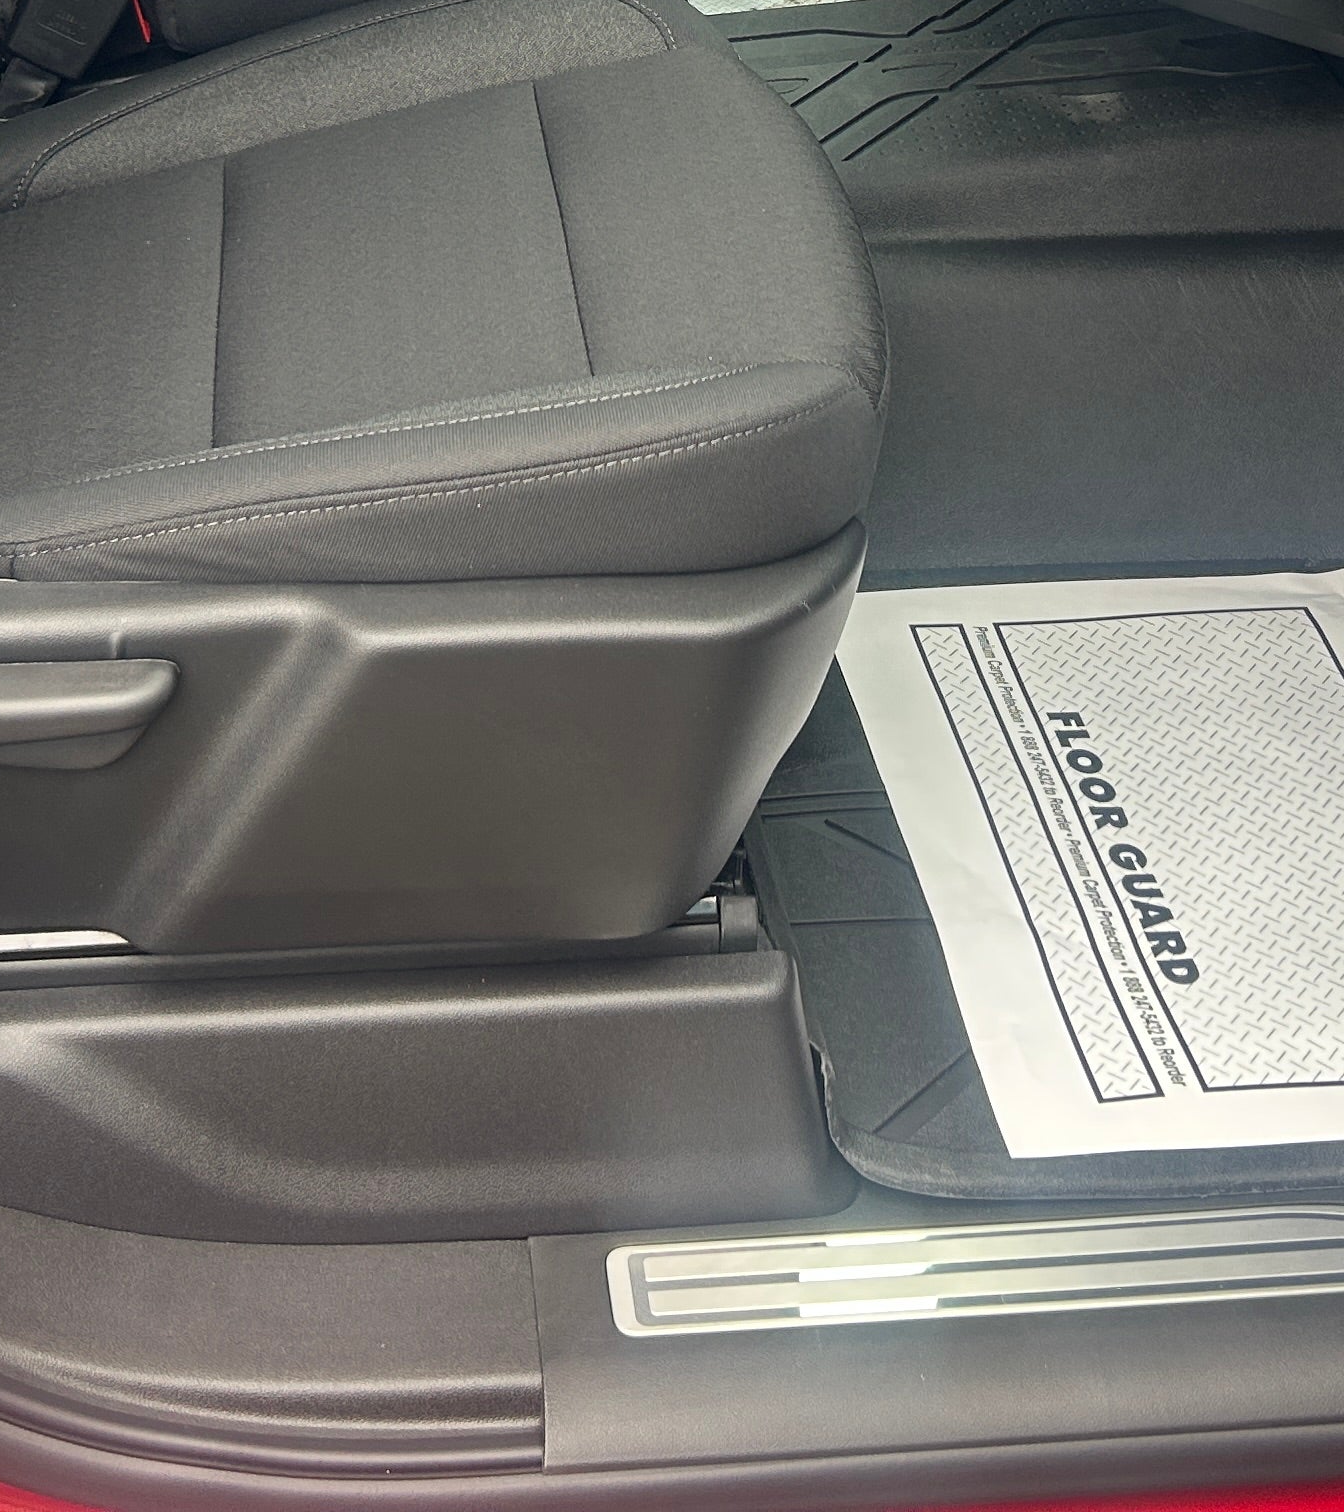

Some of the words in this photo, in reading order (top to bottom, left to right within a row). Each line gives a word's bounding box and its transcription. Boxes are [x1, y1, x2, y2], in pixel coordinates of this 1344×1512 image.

[1046, 712, 1128, 829] FLOOR
[1109, 843, 1200, 985] GUARD
[1065, 838, 1091, 877] Premium
[1083, 879, 1107, 908] Carpet
[1095, 910, 1126, 961] Protection
[1151, 1037, 1166, 1046] to
[1156, 1048, 1186, 1086] Reorder
